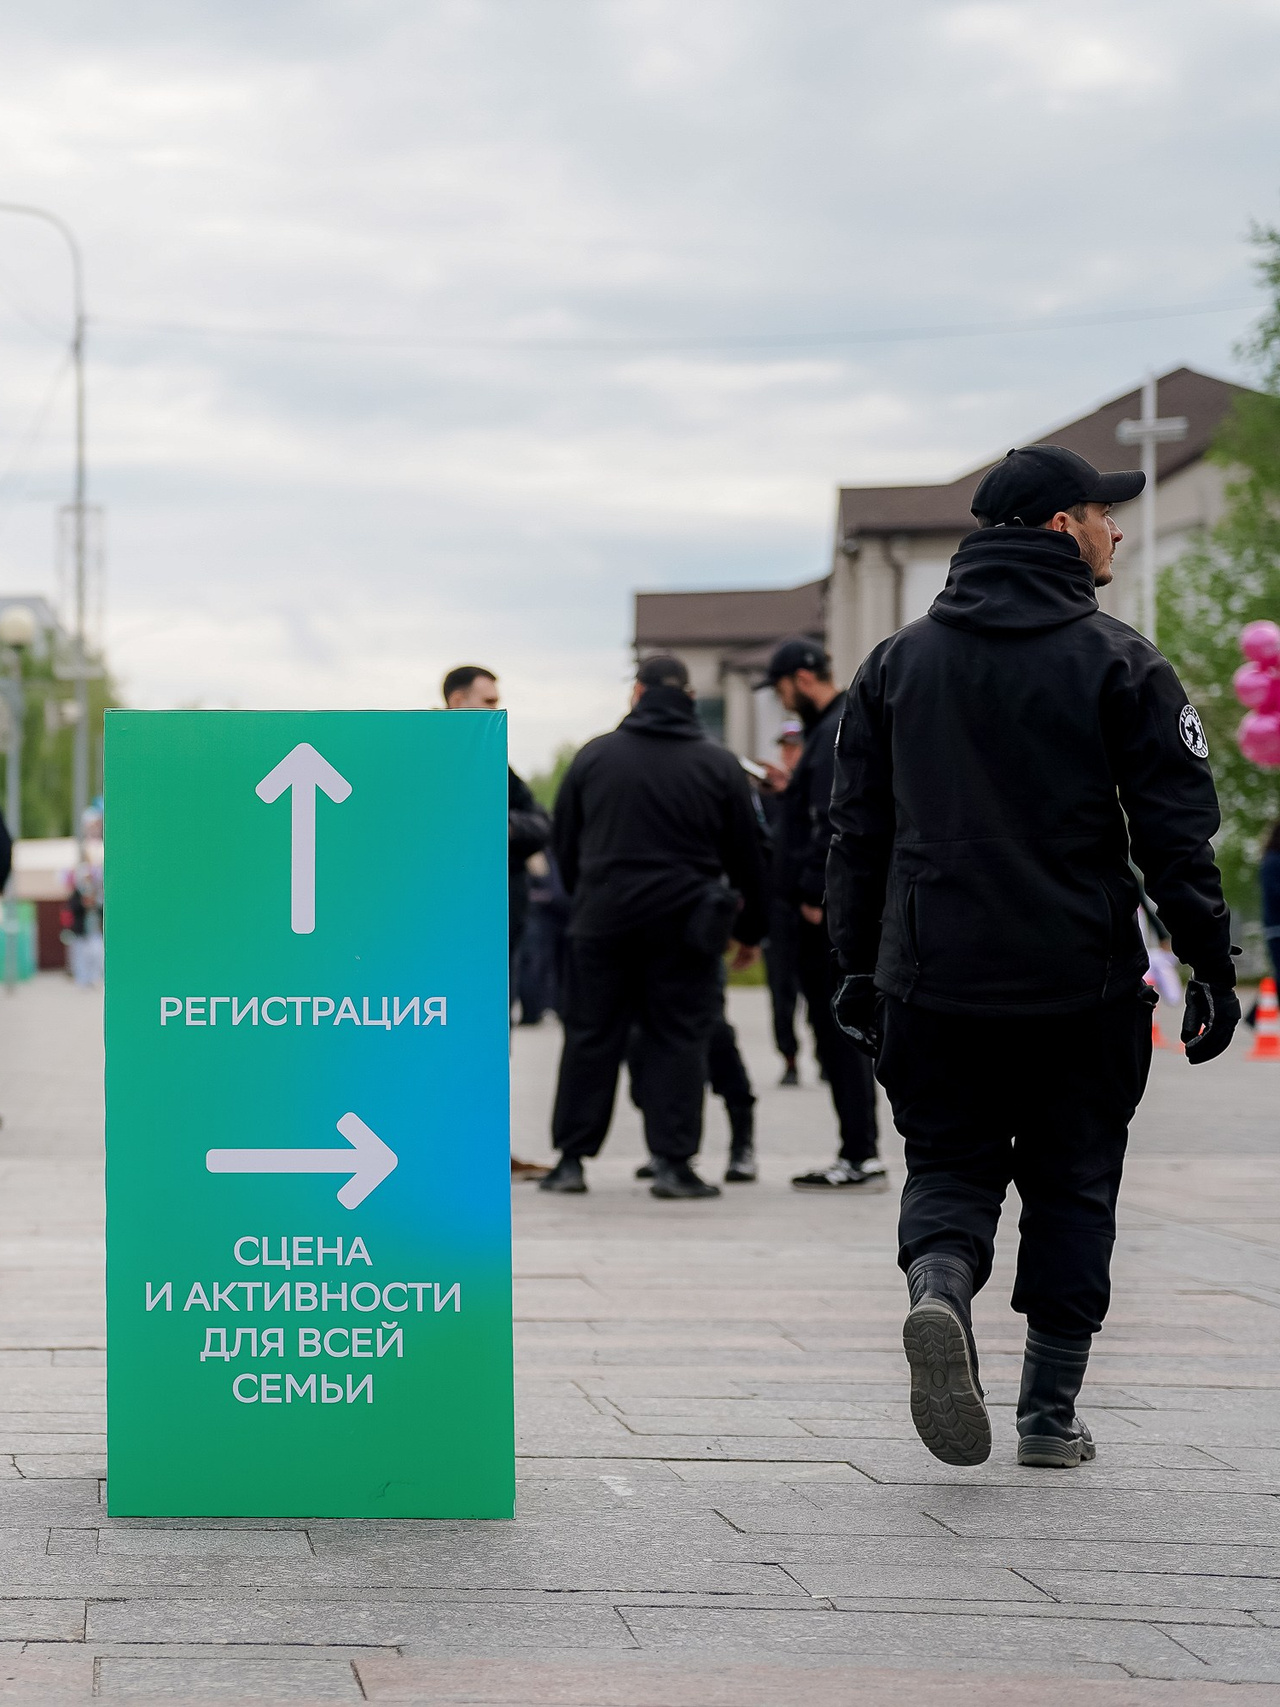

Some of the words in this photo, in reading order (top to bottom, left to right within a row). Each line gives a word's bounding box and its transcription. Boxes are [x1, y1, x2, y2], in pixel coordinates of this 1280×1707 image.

[160, 997, 447, 1031] РЕГИСТРАЦИЯ
[234, 1236, 373, 1271] СЦЕНА
[145, 1282, 173, 1312] И
[184, 1282, 462, 1312] АКТИВНОСТИ
[200, 1327, 284, 1361] ДЛЯ
[298, 1321, 405, 1358] ВСЕЙ
[233, 1374, 373, 1404] СЕМЬИ
